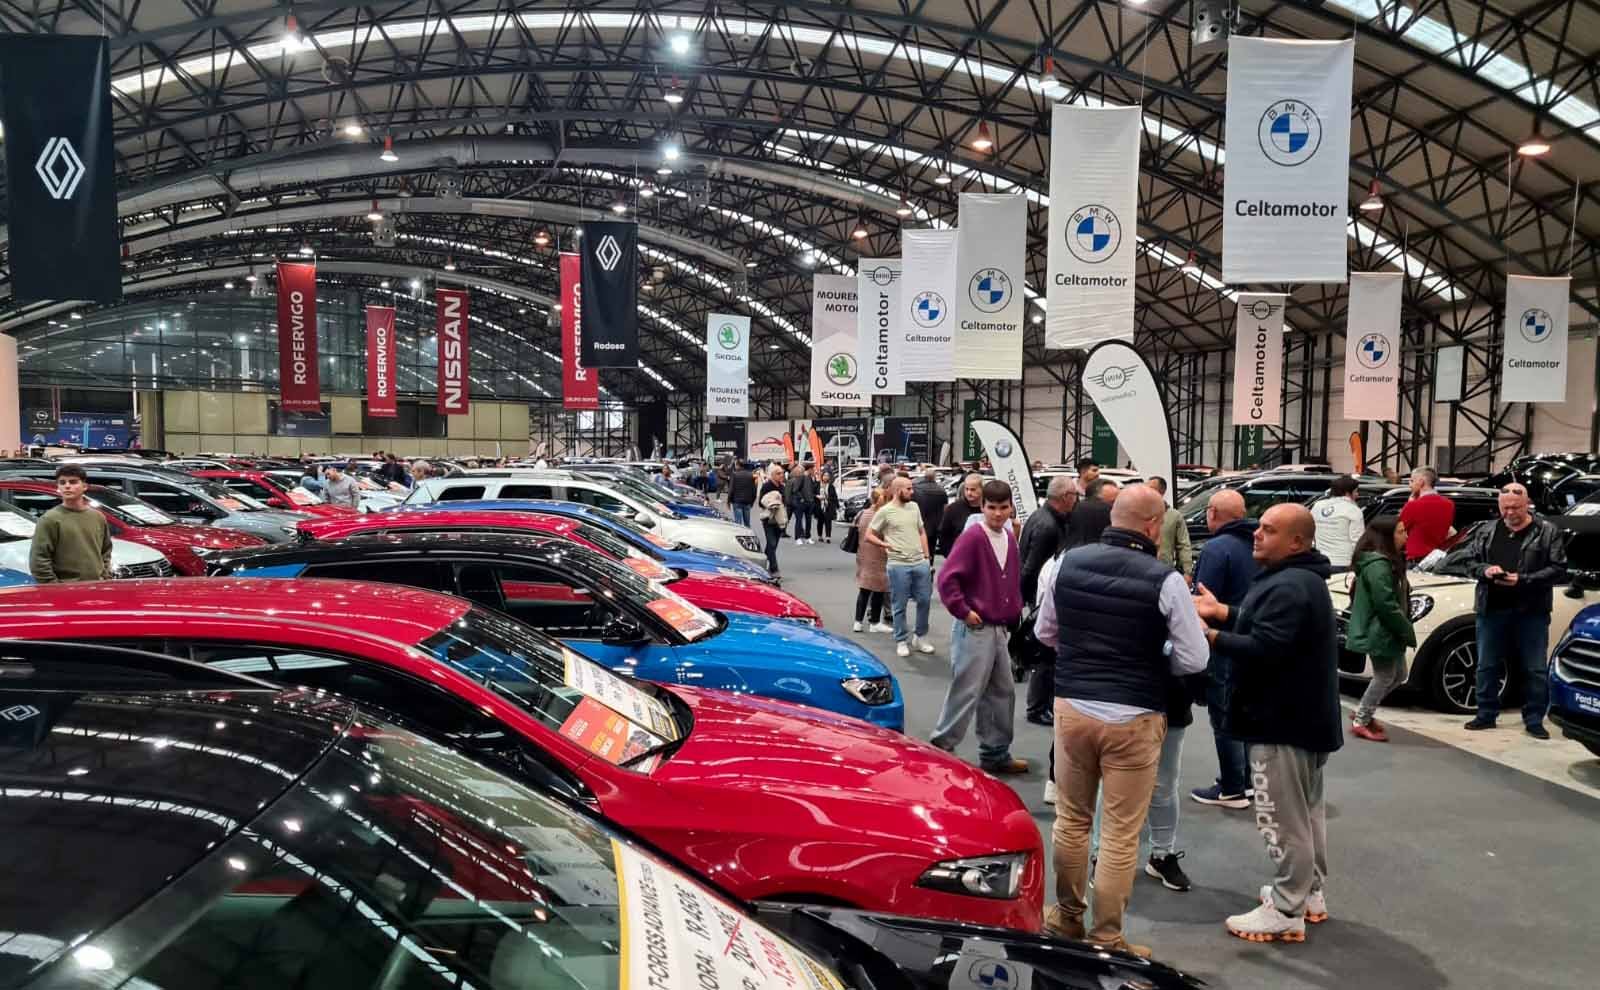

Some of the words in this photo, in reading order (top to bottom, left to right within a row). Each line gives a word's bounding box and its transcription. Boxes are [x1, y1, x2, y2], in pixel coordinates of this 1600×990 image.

[1267, 103, 1310, 121] BMW
[1073, 207, 1115, 223] BMW
[1235, 199, 1338, 217] Celtamotor
[1055, 273, 1128, 287] Celtamotor
[961, 320, 1017, 331] Celtamotor
[290, 291, 307, 385] ROFERVIGO
[874, 292, 889, 389] Celtamotor
[905, 333, 952, 343] Celtamotor
[444, 296, 461, 409] NISSAN
[376, 327, 388, 398] ROFERVIGO
[1508, 358, 1561, 369] Celtamotor
[1251, 325, 1267, 420] Celtamotor
[1350, 374, 1394, 383] Celtamotor
